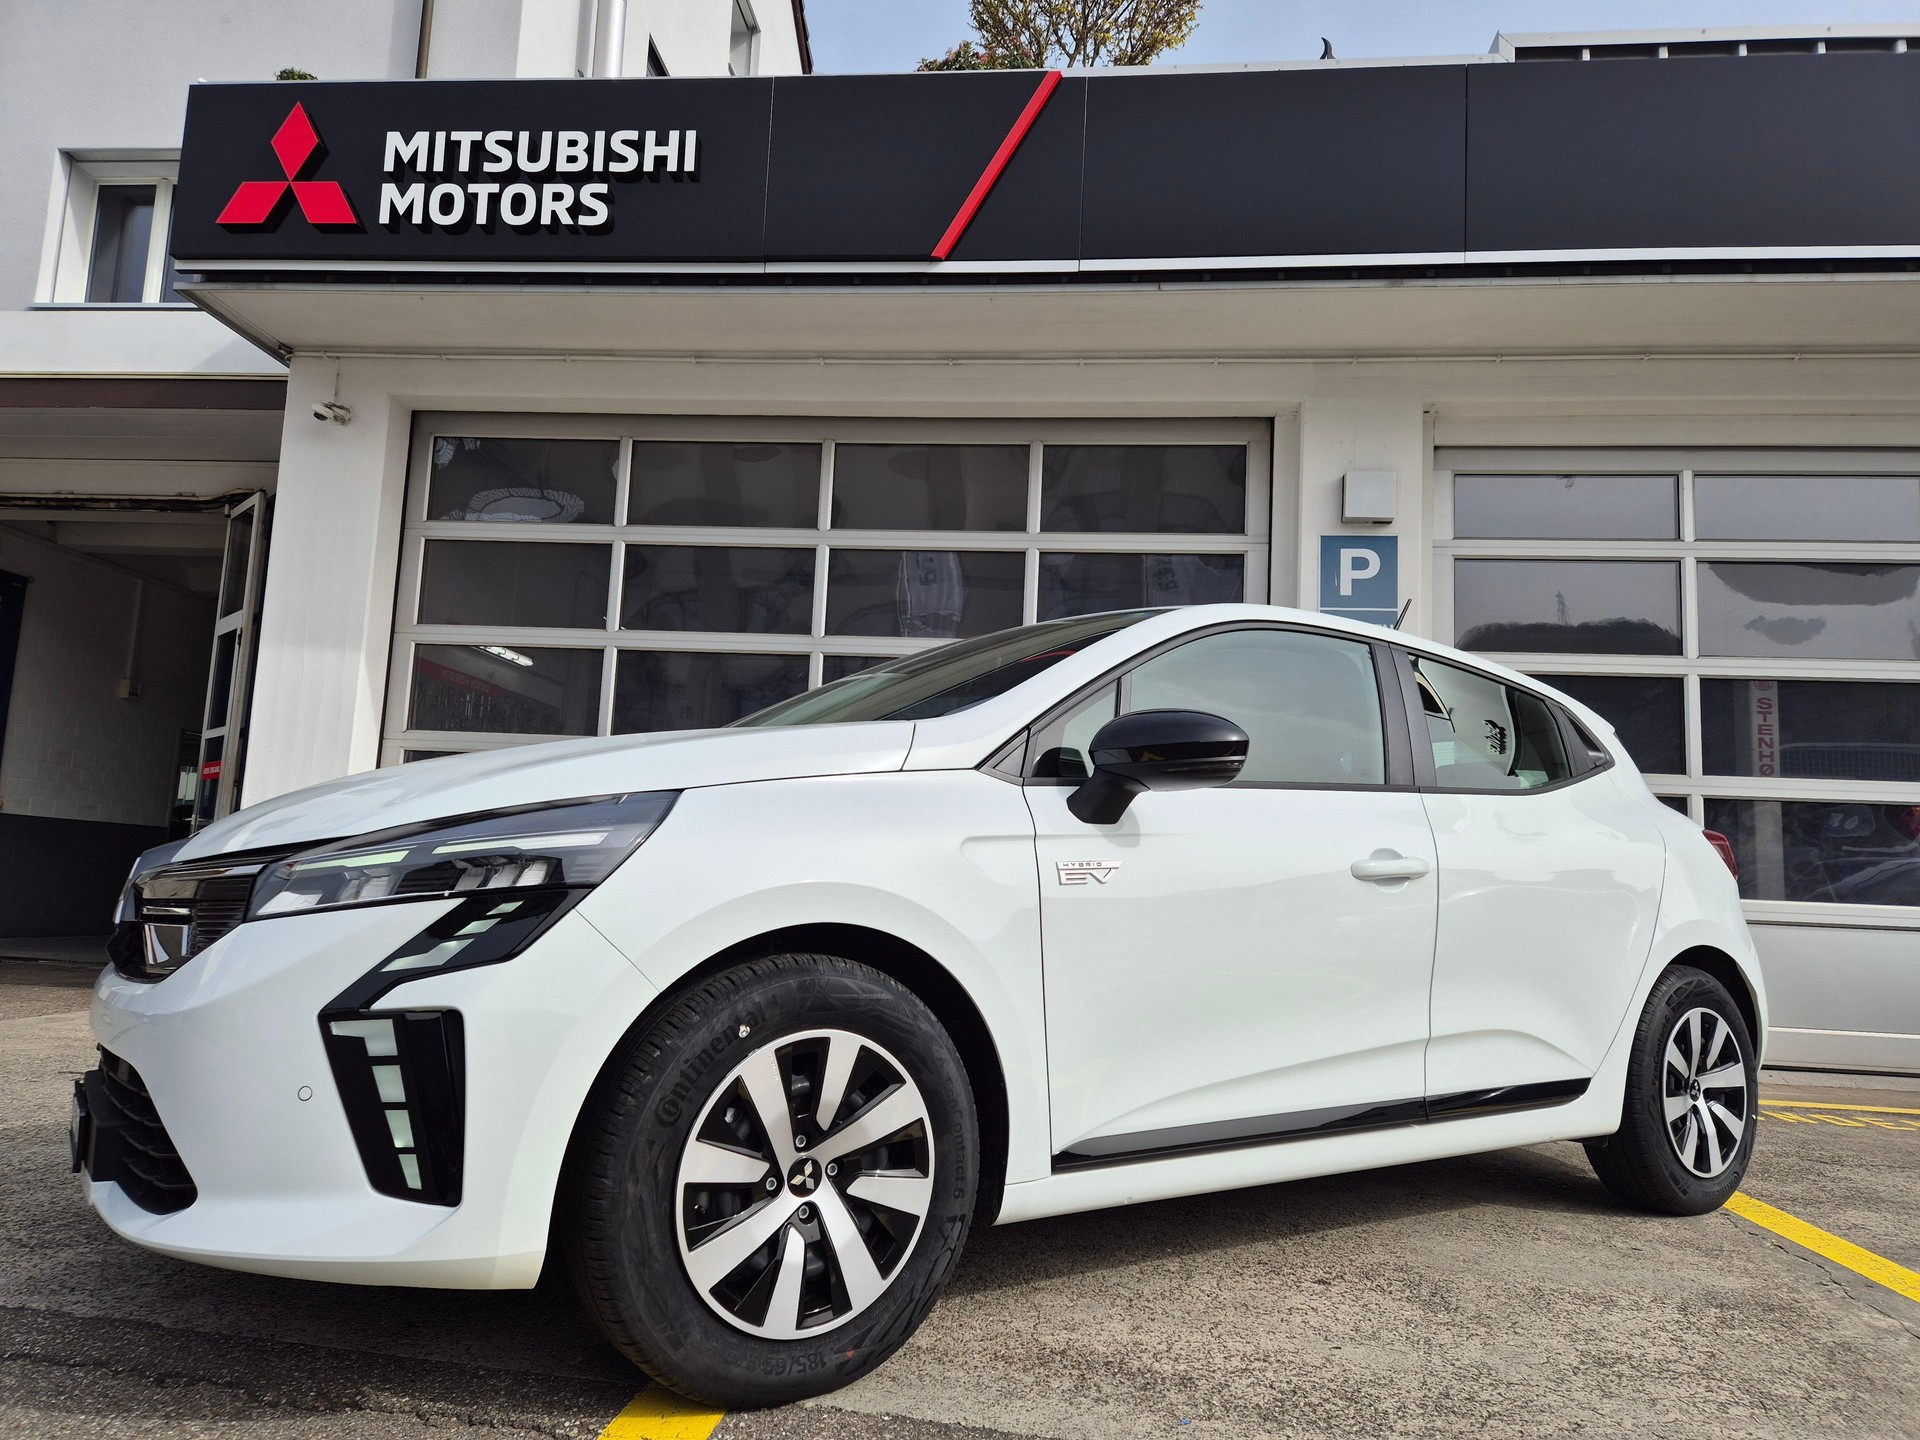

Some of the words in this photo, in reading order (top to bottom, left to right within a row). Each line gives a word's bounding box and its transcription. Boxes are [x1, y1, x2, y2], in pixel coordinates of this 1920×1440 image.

[383, 130, 697, 173] MITSUBISHI
[379, 183, 609, 226] MOTORS
[1339, 548, 1381, 596] P
[1057, 868, 1119, 885] EV
[655, 1001, 768, 1128] Continental
